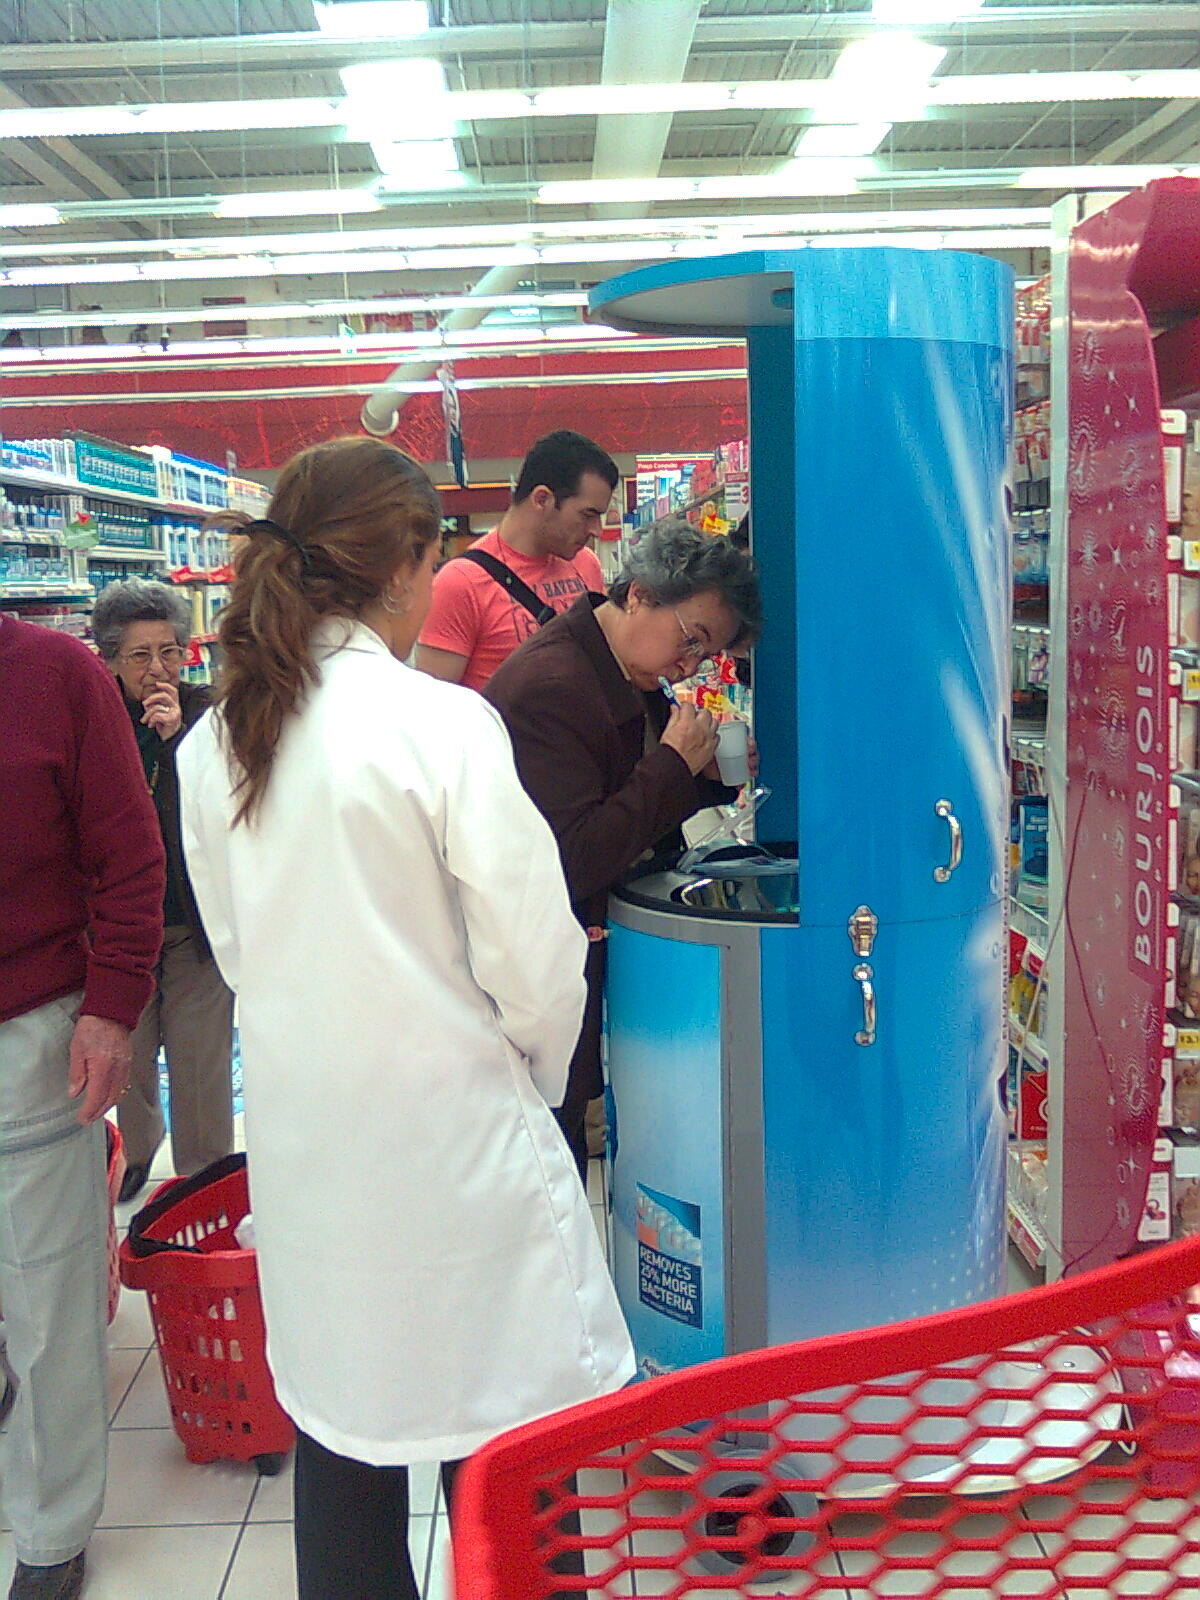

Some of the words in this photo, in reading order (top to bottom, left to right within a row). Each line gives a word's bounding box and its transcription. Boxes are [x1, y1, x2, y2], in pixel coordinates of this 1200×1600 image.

[1135, 645, 1156, 965] BOURJOIS
[641, 1245, 692, 1280] REMOVES
[641, 1278, 694, 1314] BACTERIA
[662, 1272, 697, 1298] MORE
